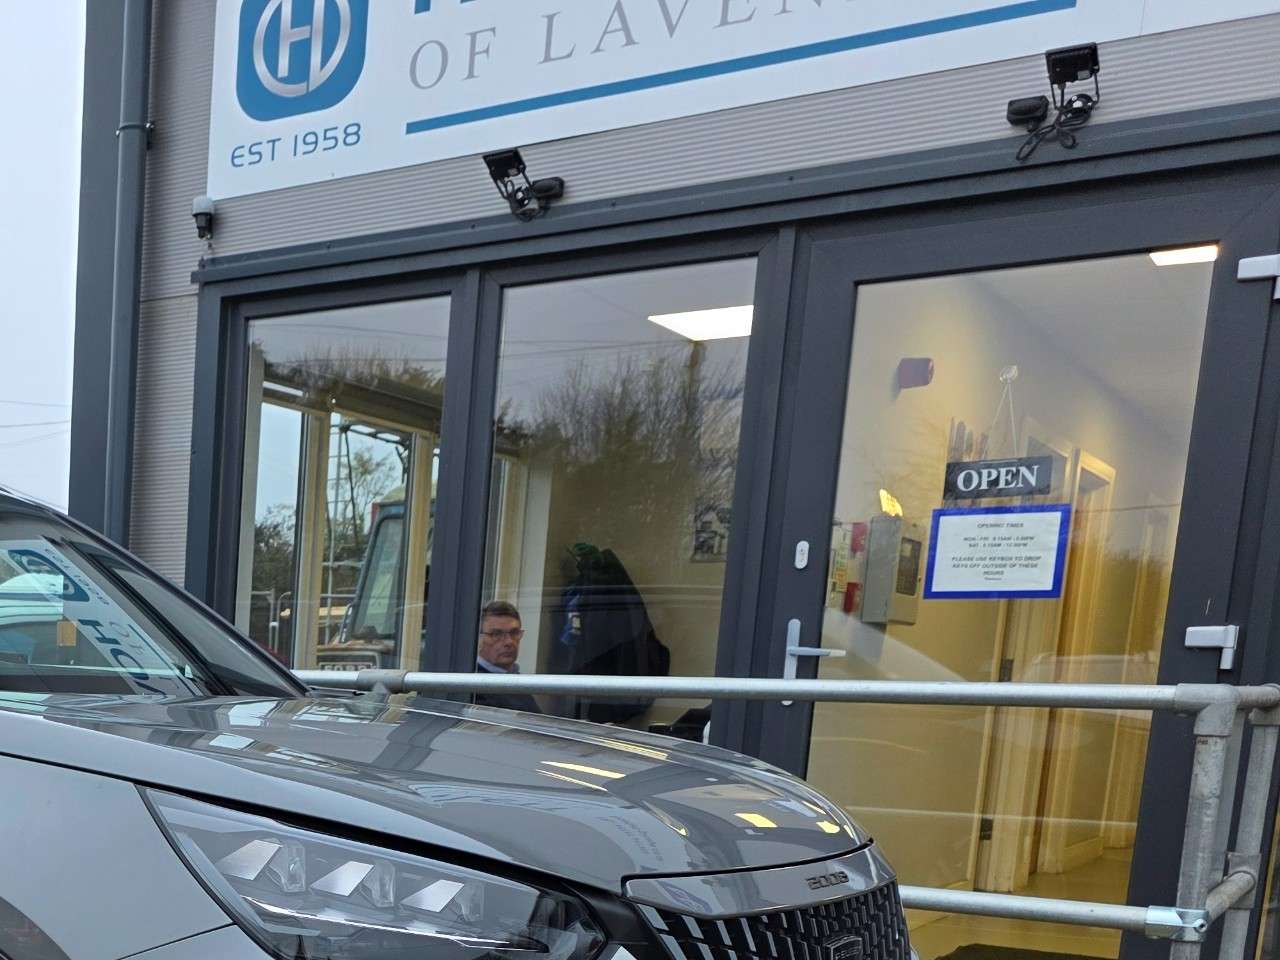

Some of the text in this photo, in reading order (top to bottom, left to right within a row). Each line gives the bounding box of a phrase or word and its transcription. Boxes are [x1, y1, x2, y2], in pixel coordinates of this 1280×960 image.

[409, 27, 497, 90] OF
[230, 122, 361, 168] EST 1958
[956, 465, 1040, 492] OPEN
